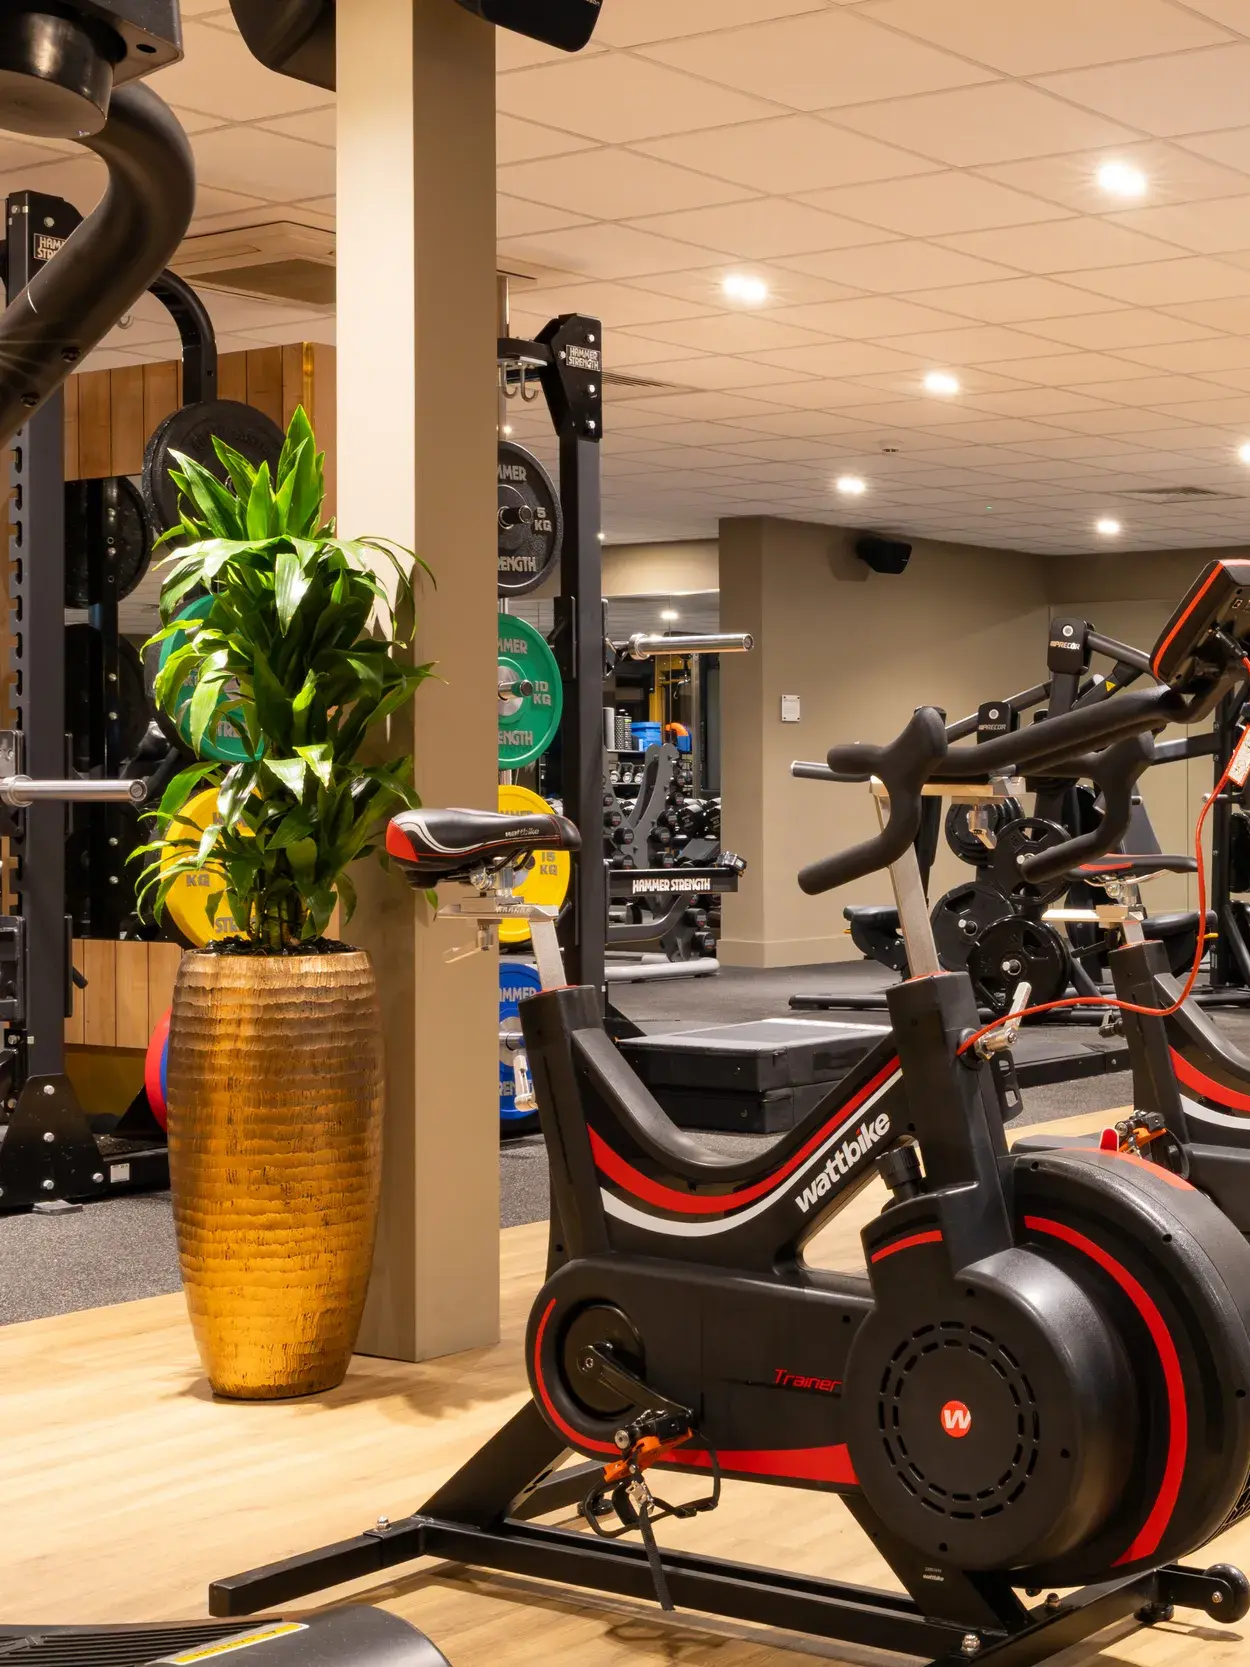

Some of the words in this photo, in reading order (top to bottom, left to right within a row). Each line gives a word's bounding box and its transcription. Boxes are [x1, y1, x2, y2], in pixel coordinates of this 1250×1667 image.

[40, 236, 66, 250] HAM
[569, 346, 598, 361] HAMMER
[568, 355, 599, 370] STRENGTH
[536, 506, 547, 518] 5
[534, 519, 552, 532] KG
[1054, 640, 1081, 651] PRECOR
[535, 680, 549, 692] 10
[533, 693, 552, 706] KG
[541, 851, 556, 863] 15
[539, 863, 559, 876] KG
[185, 873, 211, 888] KG
[632, 878, 670, 895] HAMMER
[670, 877, 712, 892] STRENGTH
[794, 1112, 891, 1213] wattbike
[774, 1367, 843, 1392] Trainer
